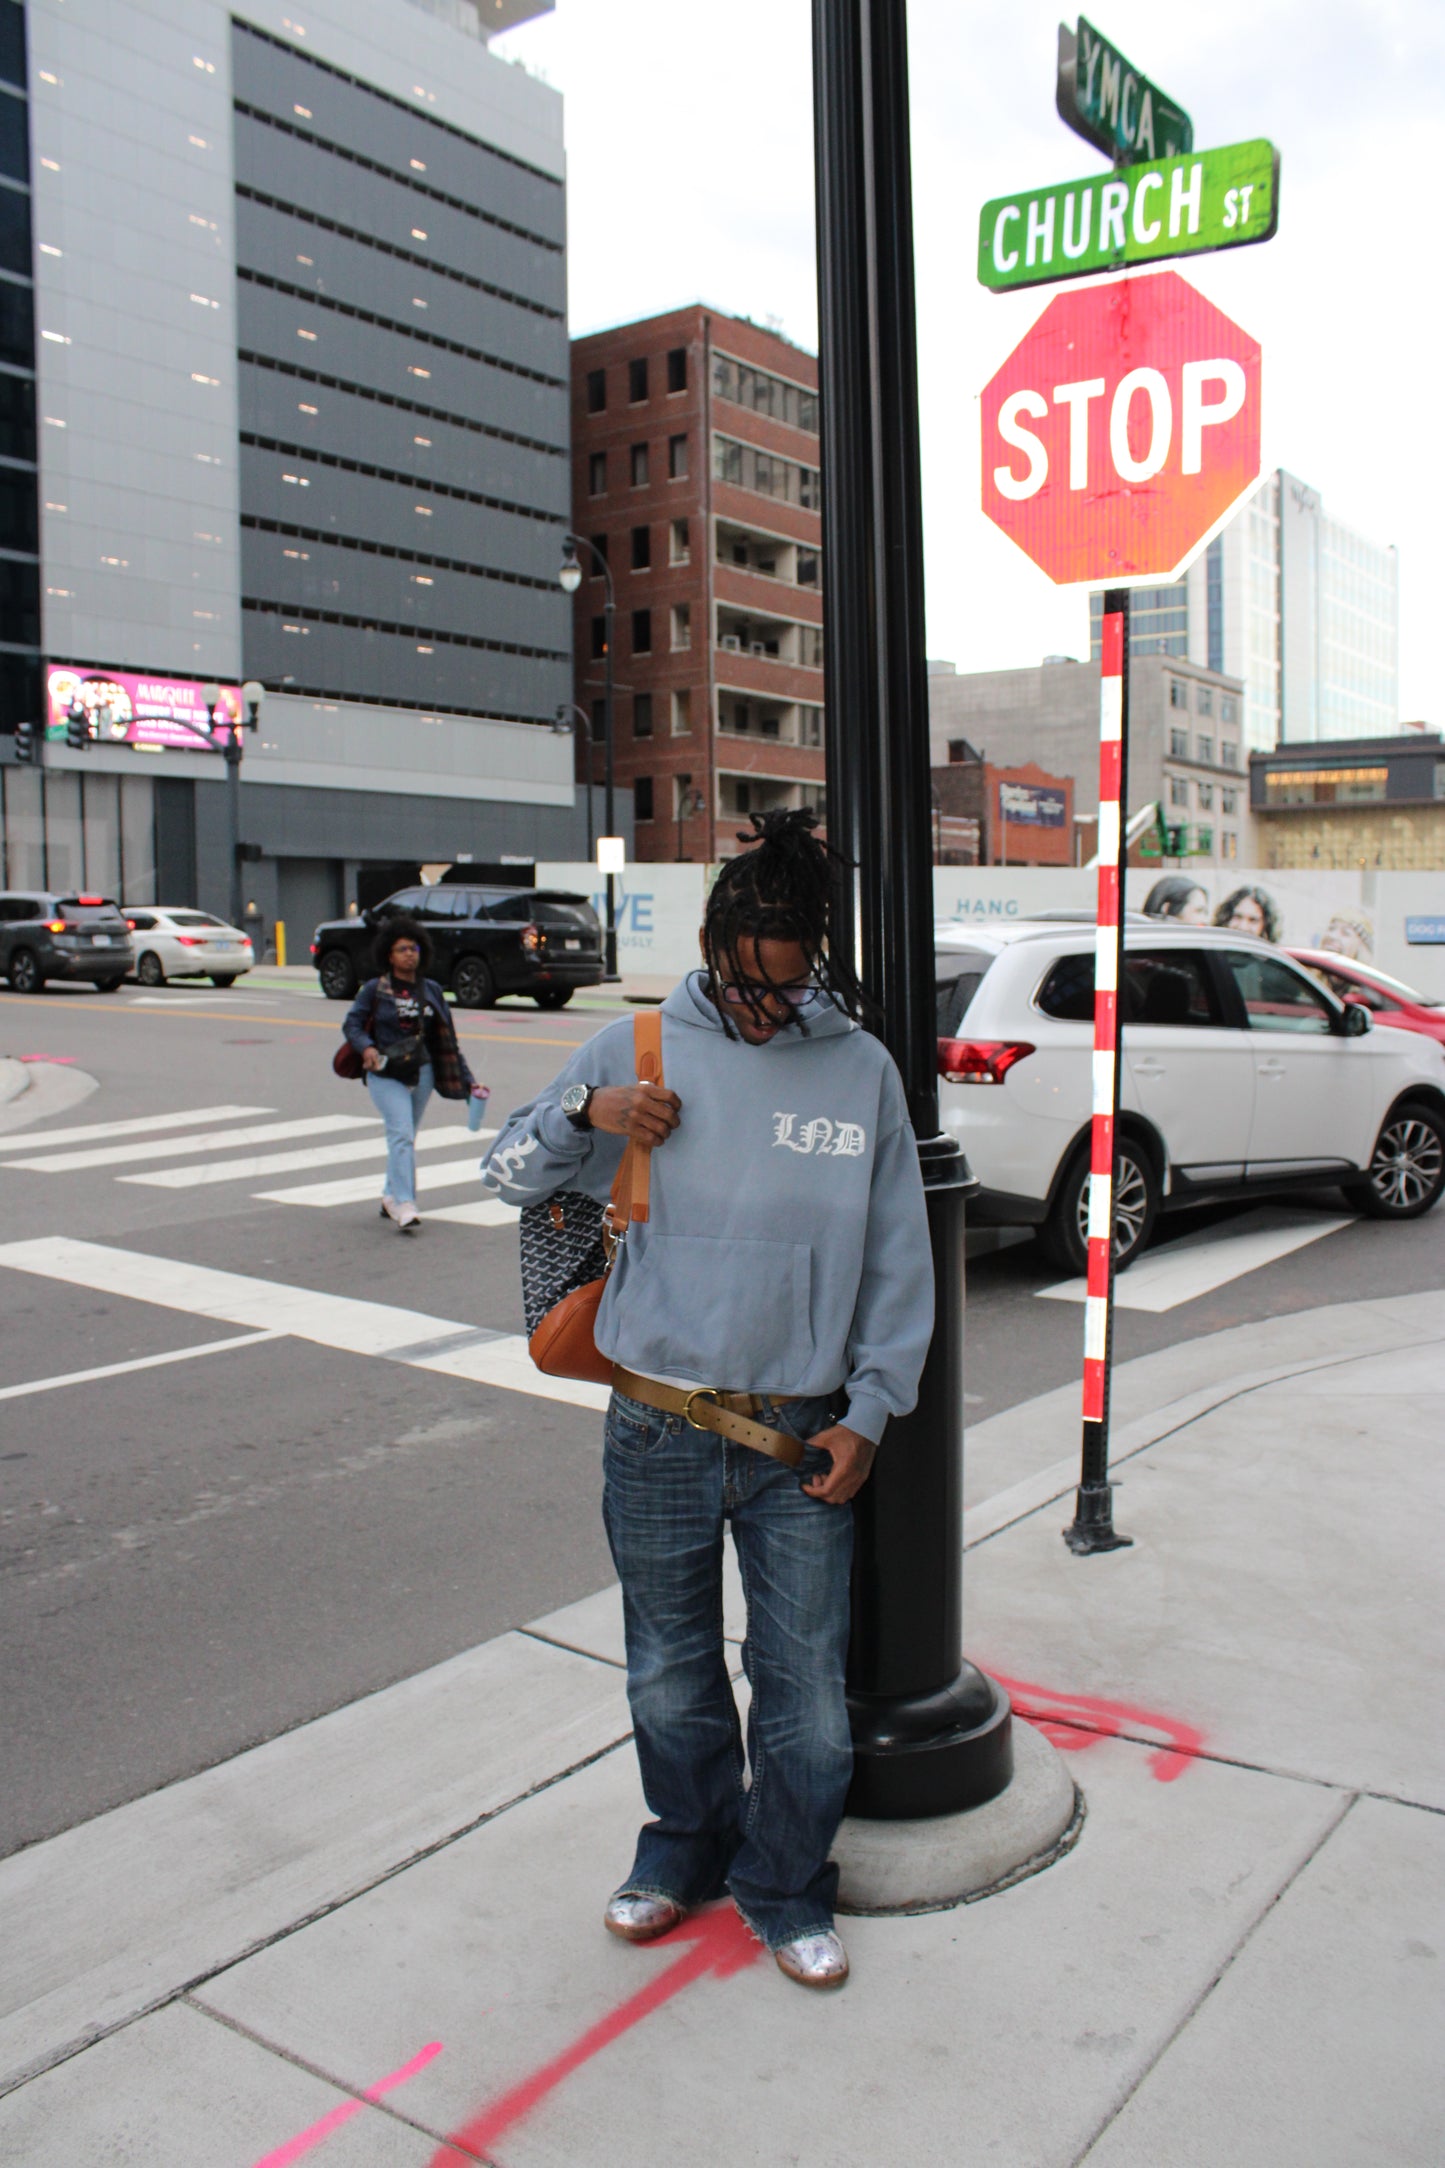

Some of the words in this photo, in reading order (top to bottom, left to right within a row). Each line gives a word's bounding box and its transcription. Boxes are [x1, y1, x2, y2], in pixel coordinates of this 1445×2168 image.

[1083, 30, 1156, 160] YMCA
[992, 163, 1203, 273] CHURCH
[1222, 184, 1254, 228] ST
[993, 357, 1247, 501] STOP
[956, 898, 1019, 915] HANG
